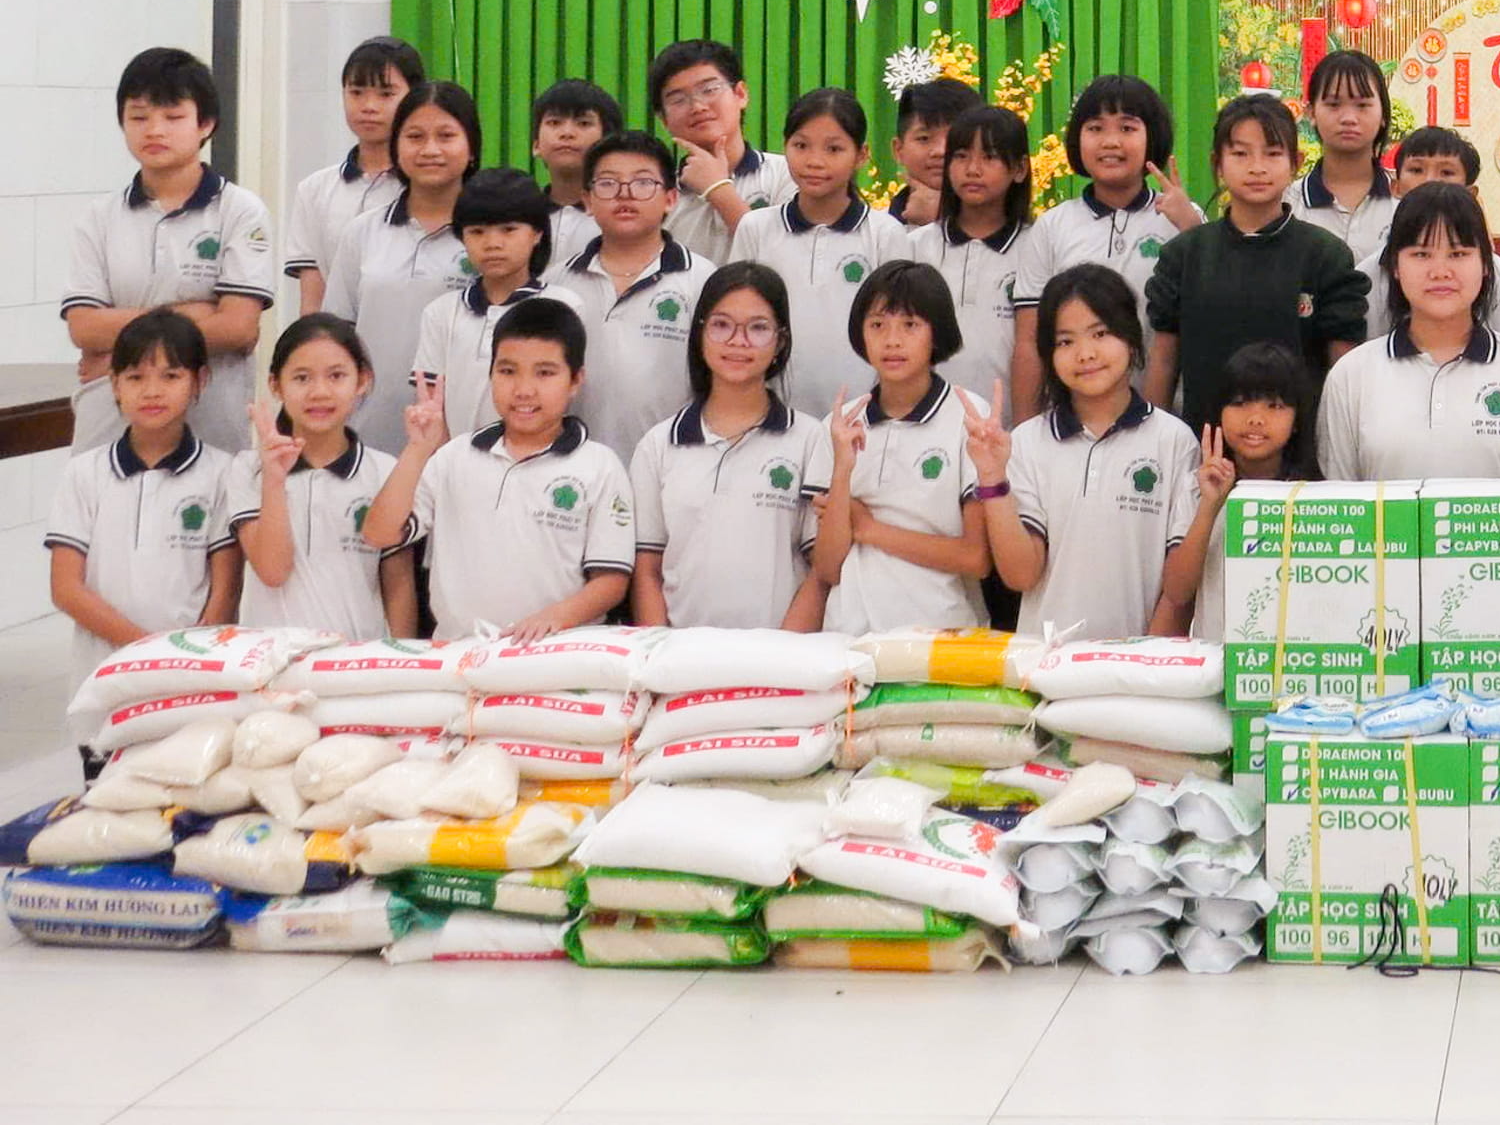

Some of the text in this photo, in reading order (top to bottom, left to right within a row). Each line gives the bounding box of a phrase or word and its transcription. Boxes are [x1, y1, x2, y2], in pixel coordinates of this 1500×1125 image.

[1342, 505, 1364, 516] 100
[1262, 523, 1354, 535] PHI GIA
[1454, 522, 1475, 533] PHI
[1235, 648, 1362, 671] TẬP SINH
[1433, 646, 1464, 668] TẬP
